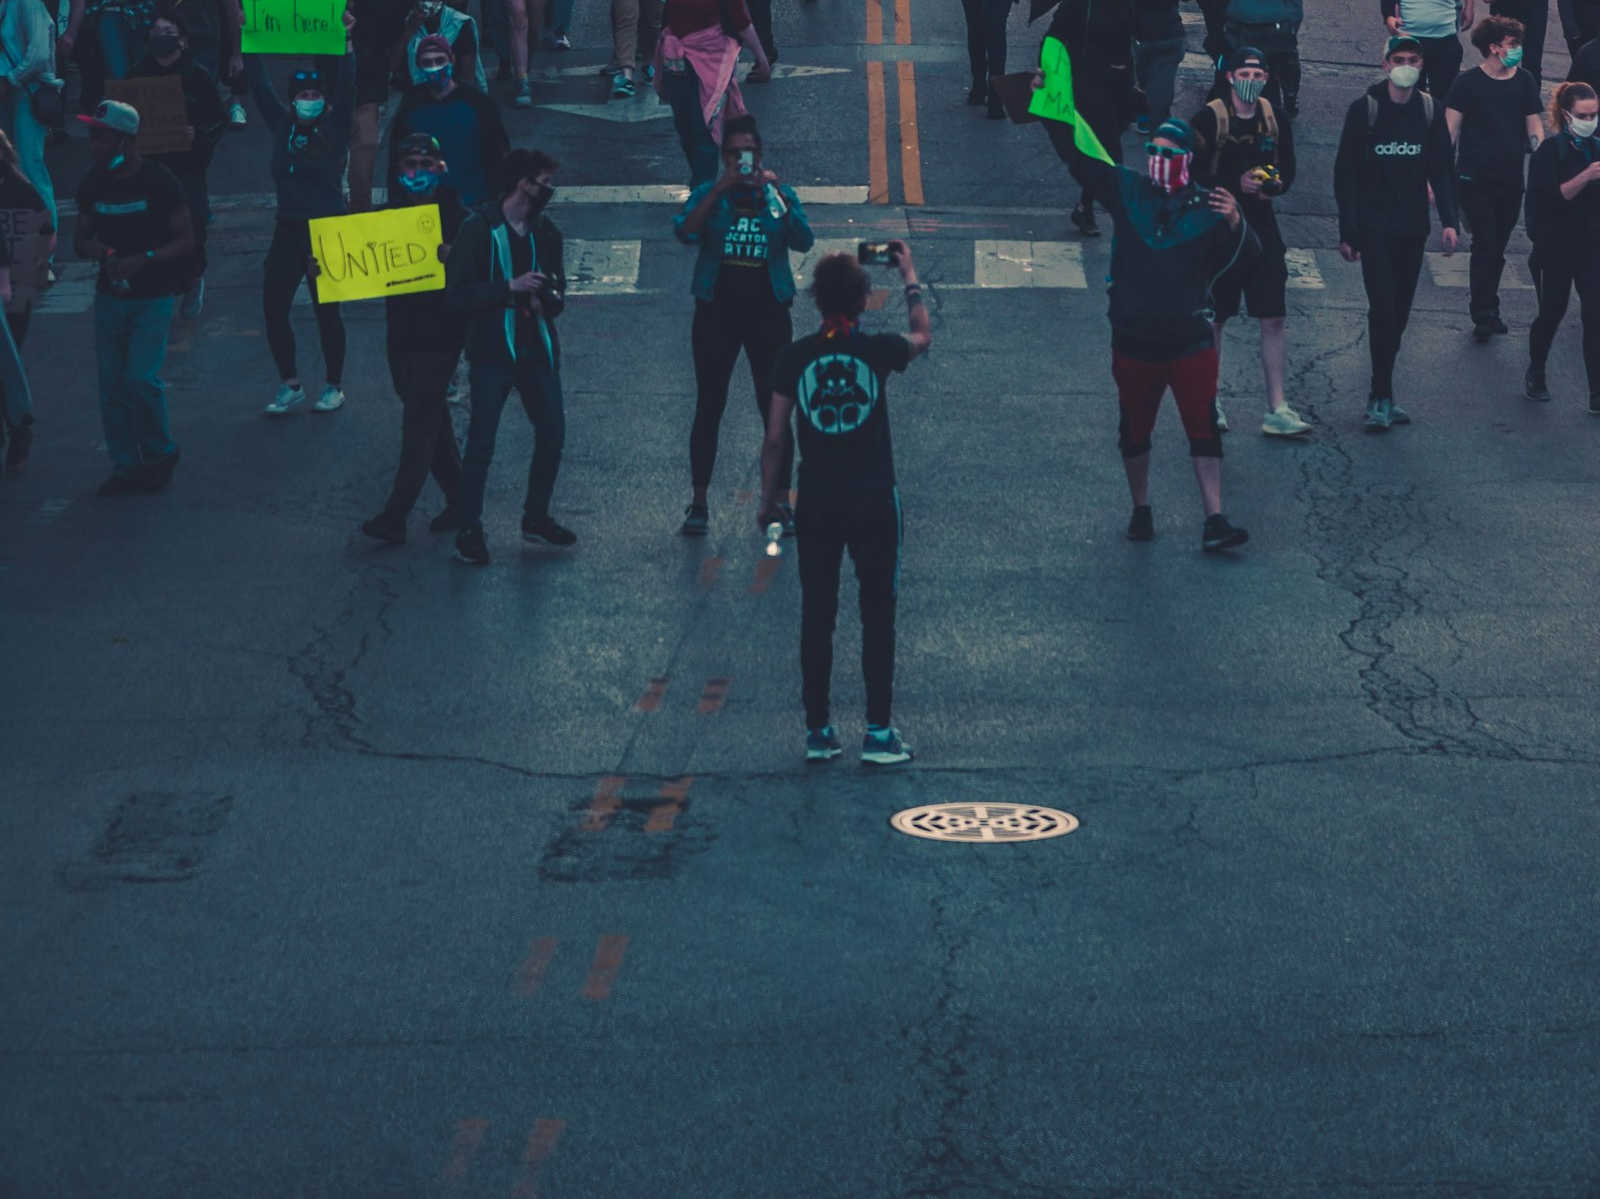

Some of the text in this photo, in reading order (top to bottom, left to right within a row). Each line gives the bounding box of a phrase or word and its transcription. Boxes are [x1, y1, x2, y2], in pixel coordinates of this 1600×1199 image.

[1375, 142, 1421, 155] adidas
[318, 231, 427, 283] UNITED
[724, 242, 769, 259] ATTE
